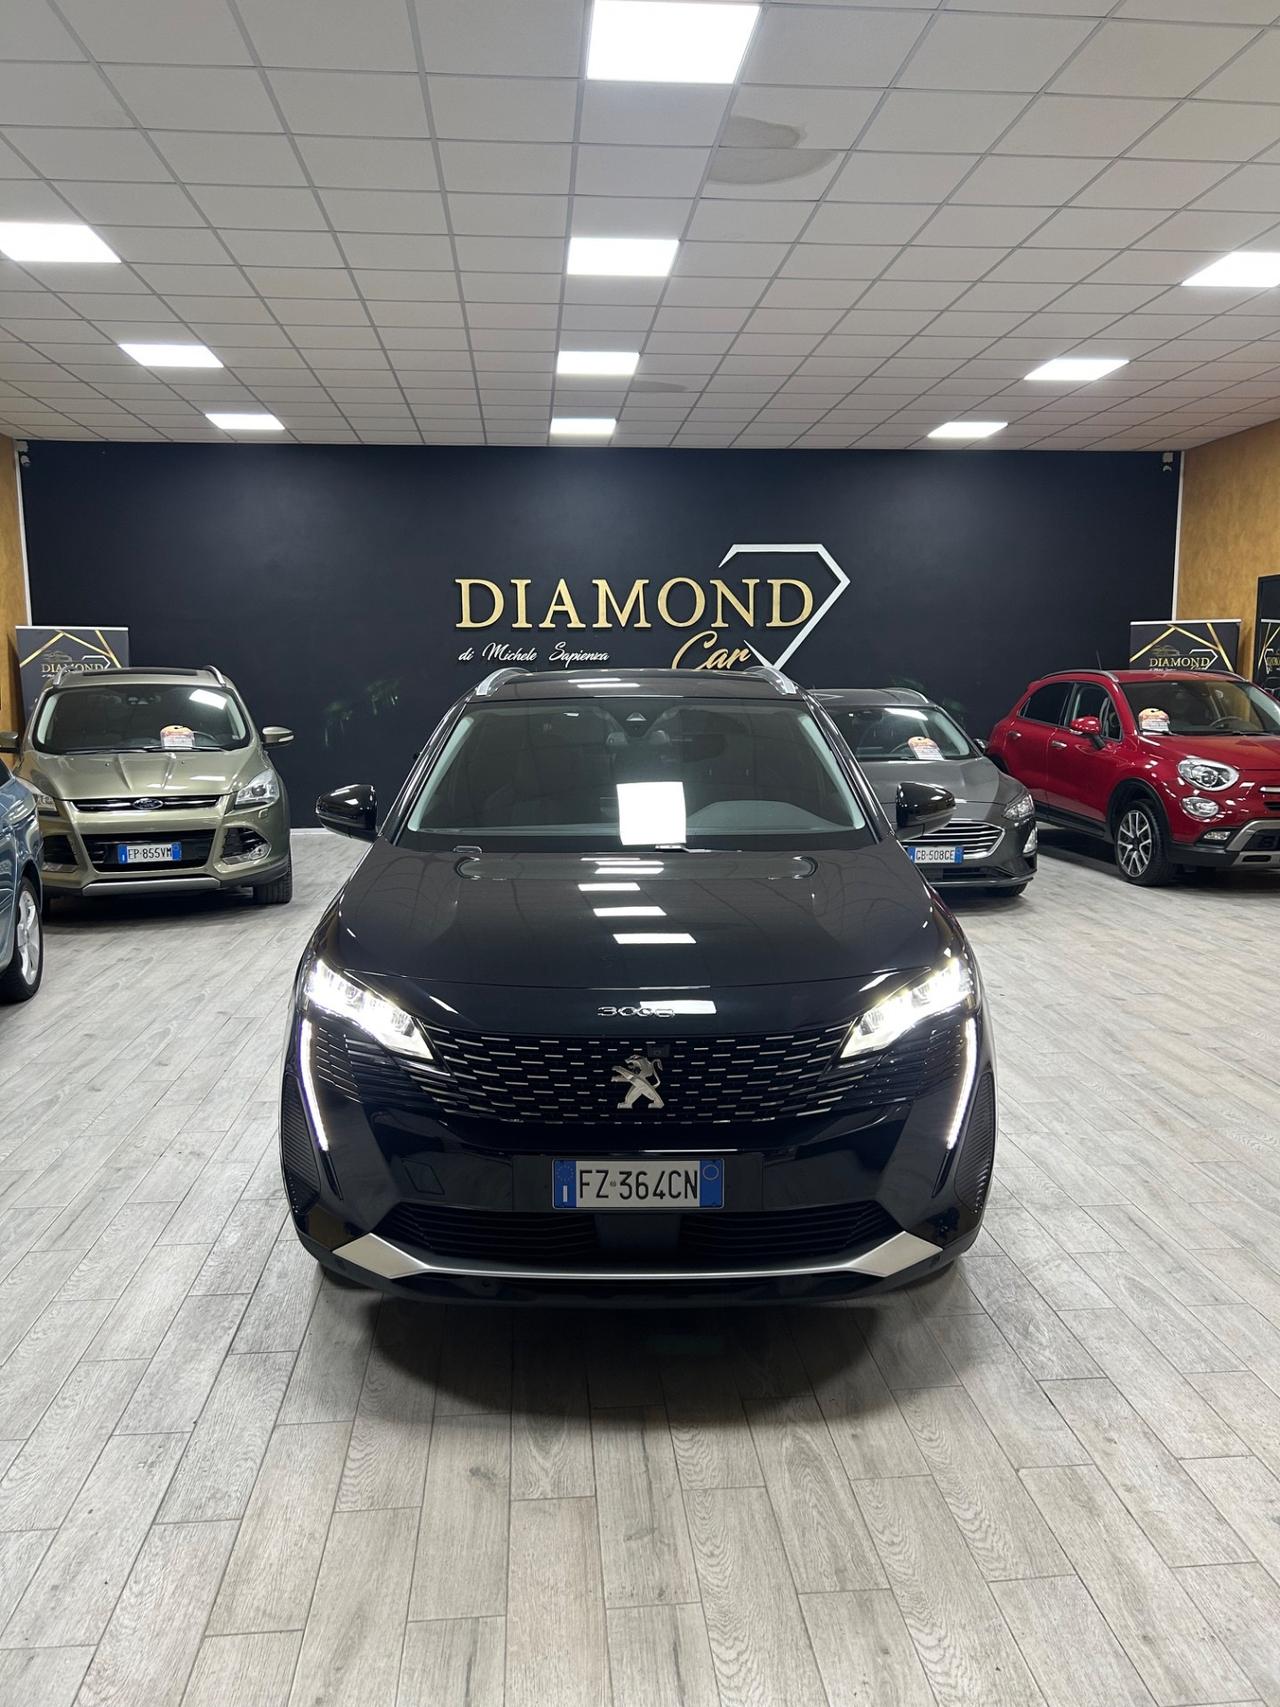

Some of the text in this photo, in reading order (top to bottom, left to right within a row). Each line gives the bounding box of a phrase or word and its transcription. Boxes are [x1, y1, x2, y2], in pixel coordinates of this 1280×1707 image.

[454, 577, 815, 629] DIAMOND
[458, 641, 610, 668] di Michele Sapienza
[671, 630, 752, 670] Car
[1149, 657, 1211, 668] DIAMOND
[41, 663, 104, 673] DIAOND
